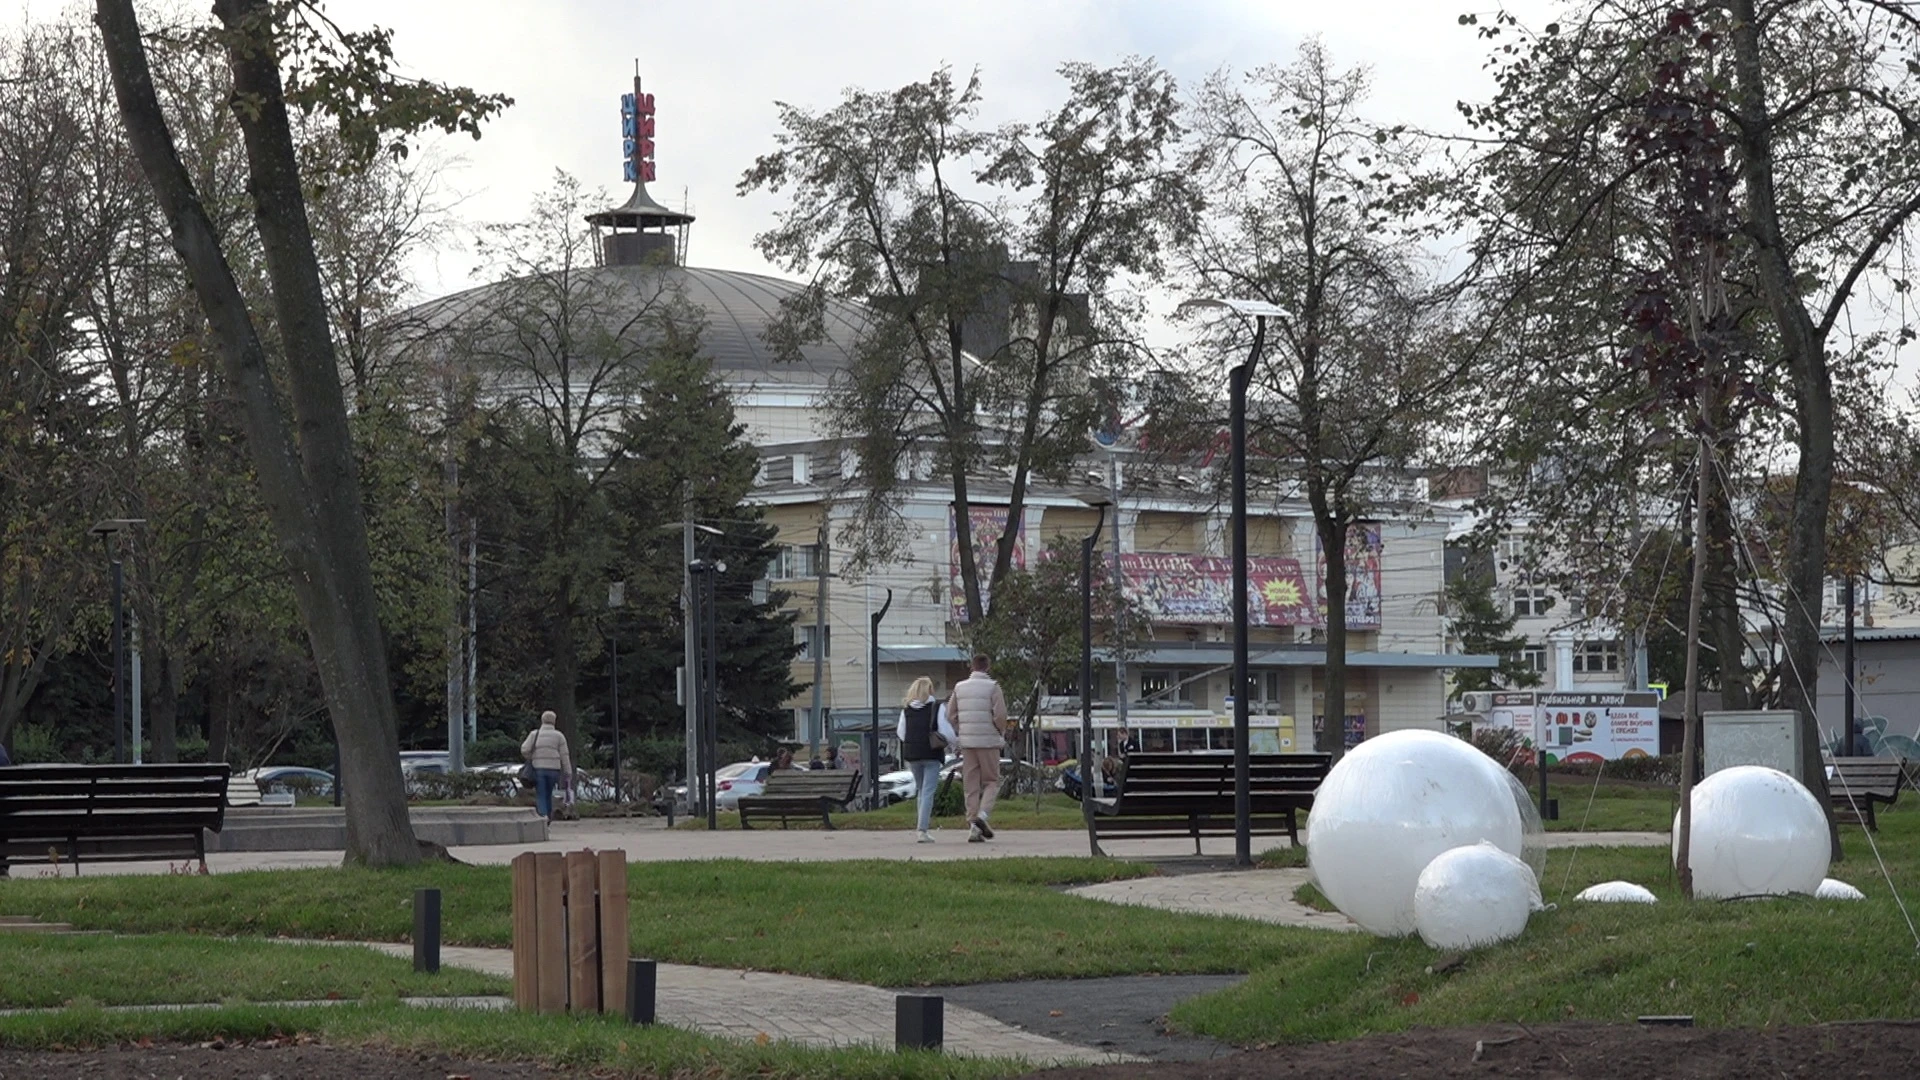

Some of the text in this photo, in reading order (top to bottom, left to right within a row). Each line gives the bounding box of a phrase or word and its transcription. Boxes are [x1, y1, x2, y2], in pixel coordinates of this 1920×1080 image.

[621, 93, 637, 182] ЦИРК
[636, 93, 656, 182] ЦИРК
[1540, 695, 1625, 705] МОБИЛЬНАЯ ЛАВКА
